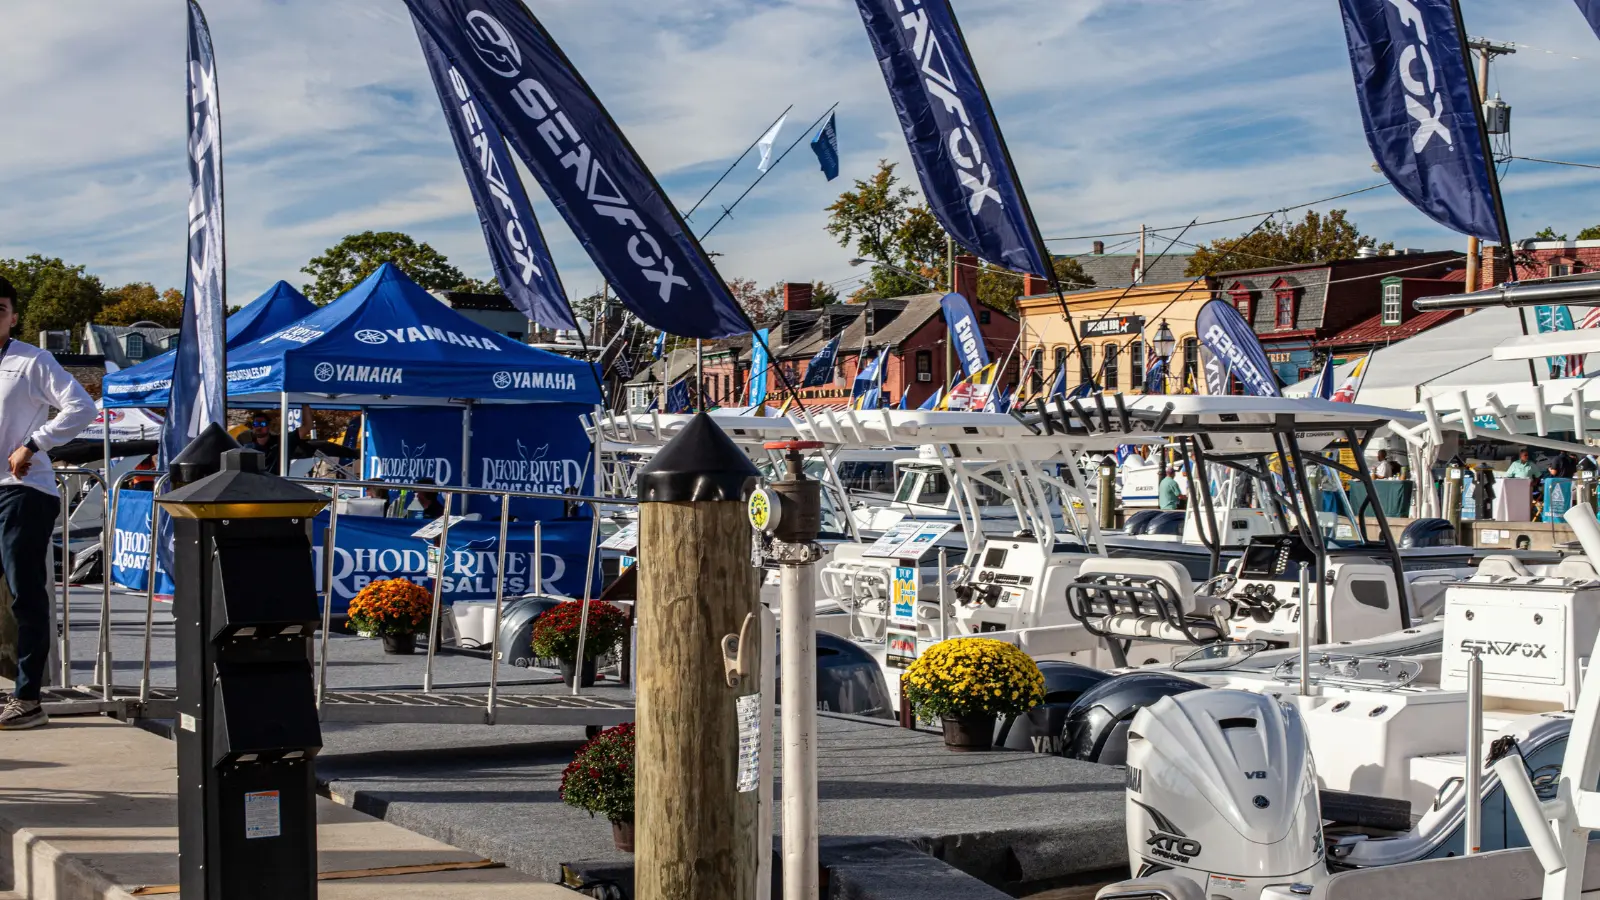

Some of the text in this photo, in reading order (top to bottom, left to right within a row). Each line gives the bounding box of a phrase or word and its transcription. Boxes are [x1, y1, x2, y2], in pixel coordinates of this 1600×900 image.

[386, 324, 502, 351] YAMAHA
[954, 315, 983, 375] Everg
[336, 364, 403, 384] YAMAHA
[513, 372, 576, 390] YAMAHA
[123, 553, 147, 569] BOAT
[452, 550, 571, 597] RIVER
[898, 569, 911, 578] TOP
[442, 576, 526, 594] SALES
[892, 578, 916, 606] 100
[1031, 736, 1062, 753] YAM
[1244, 770, 1267, 780] V8
[1146, 829, 1202, 857] XTO
